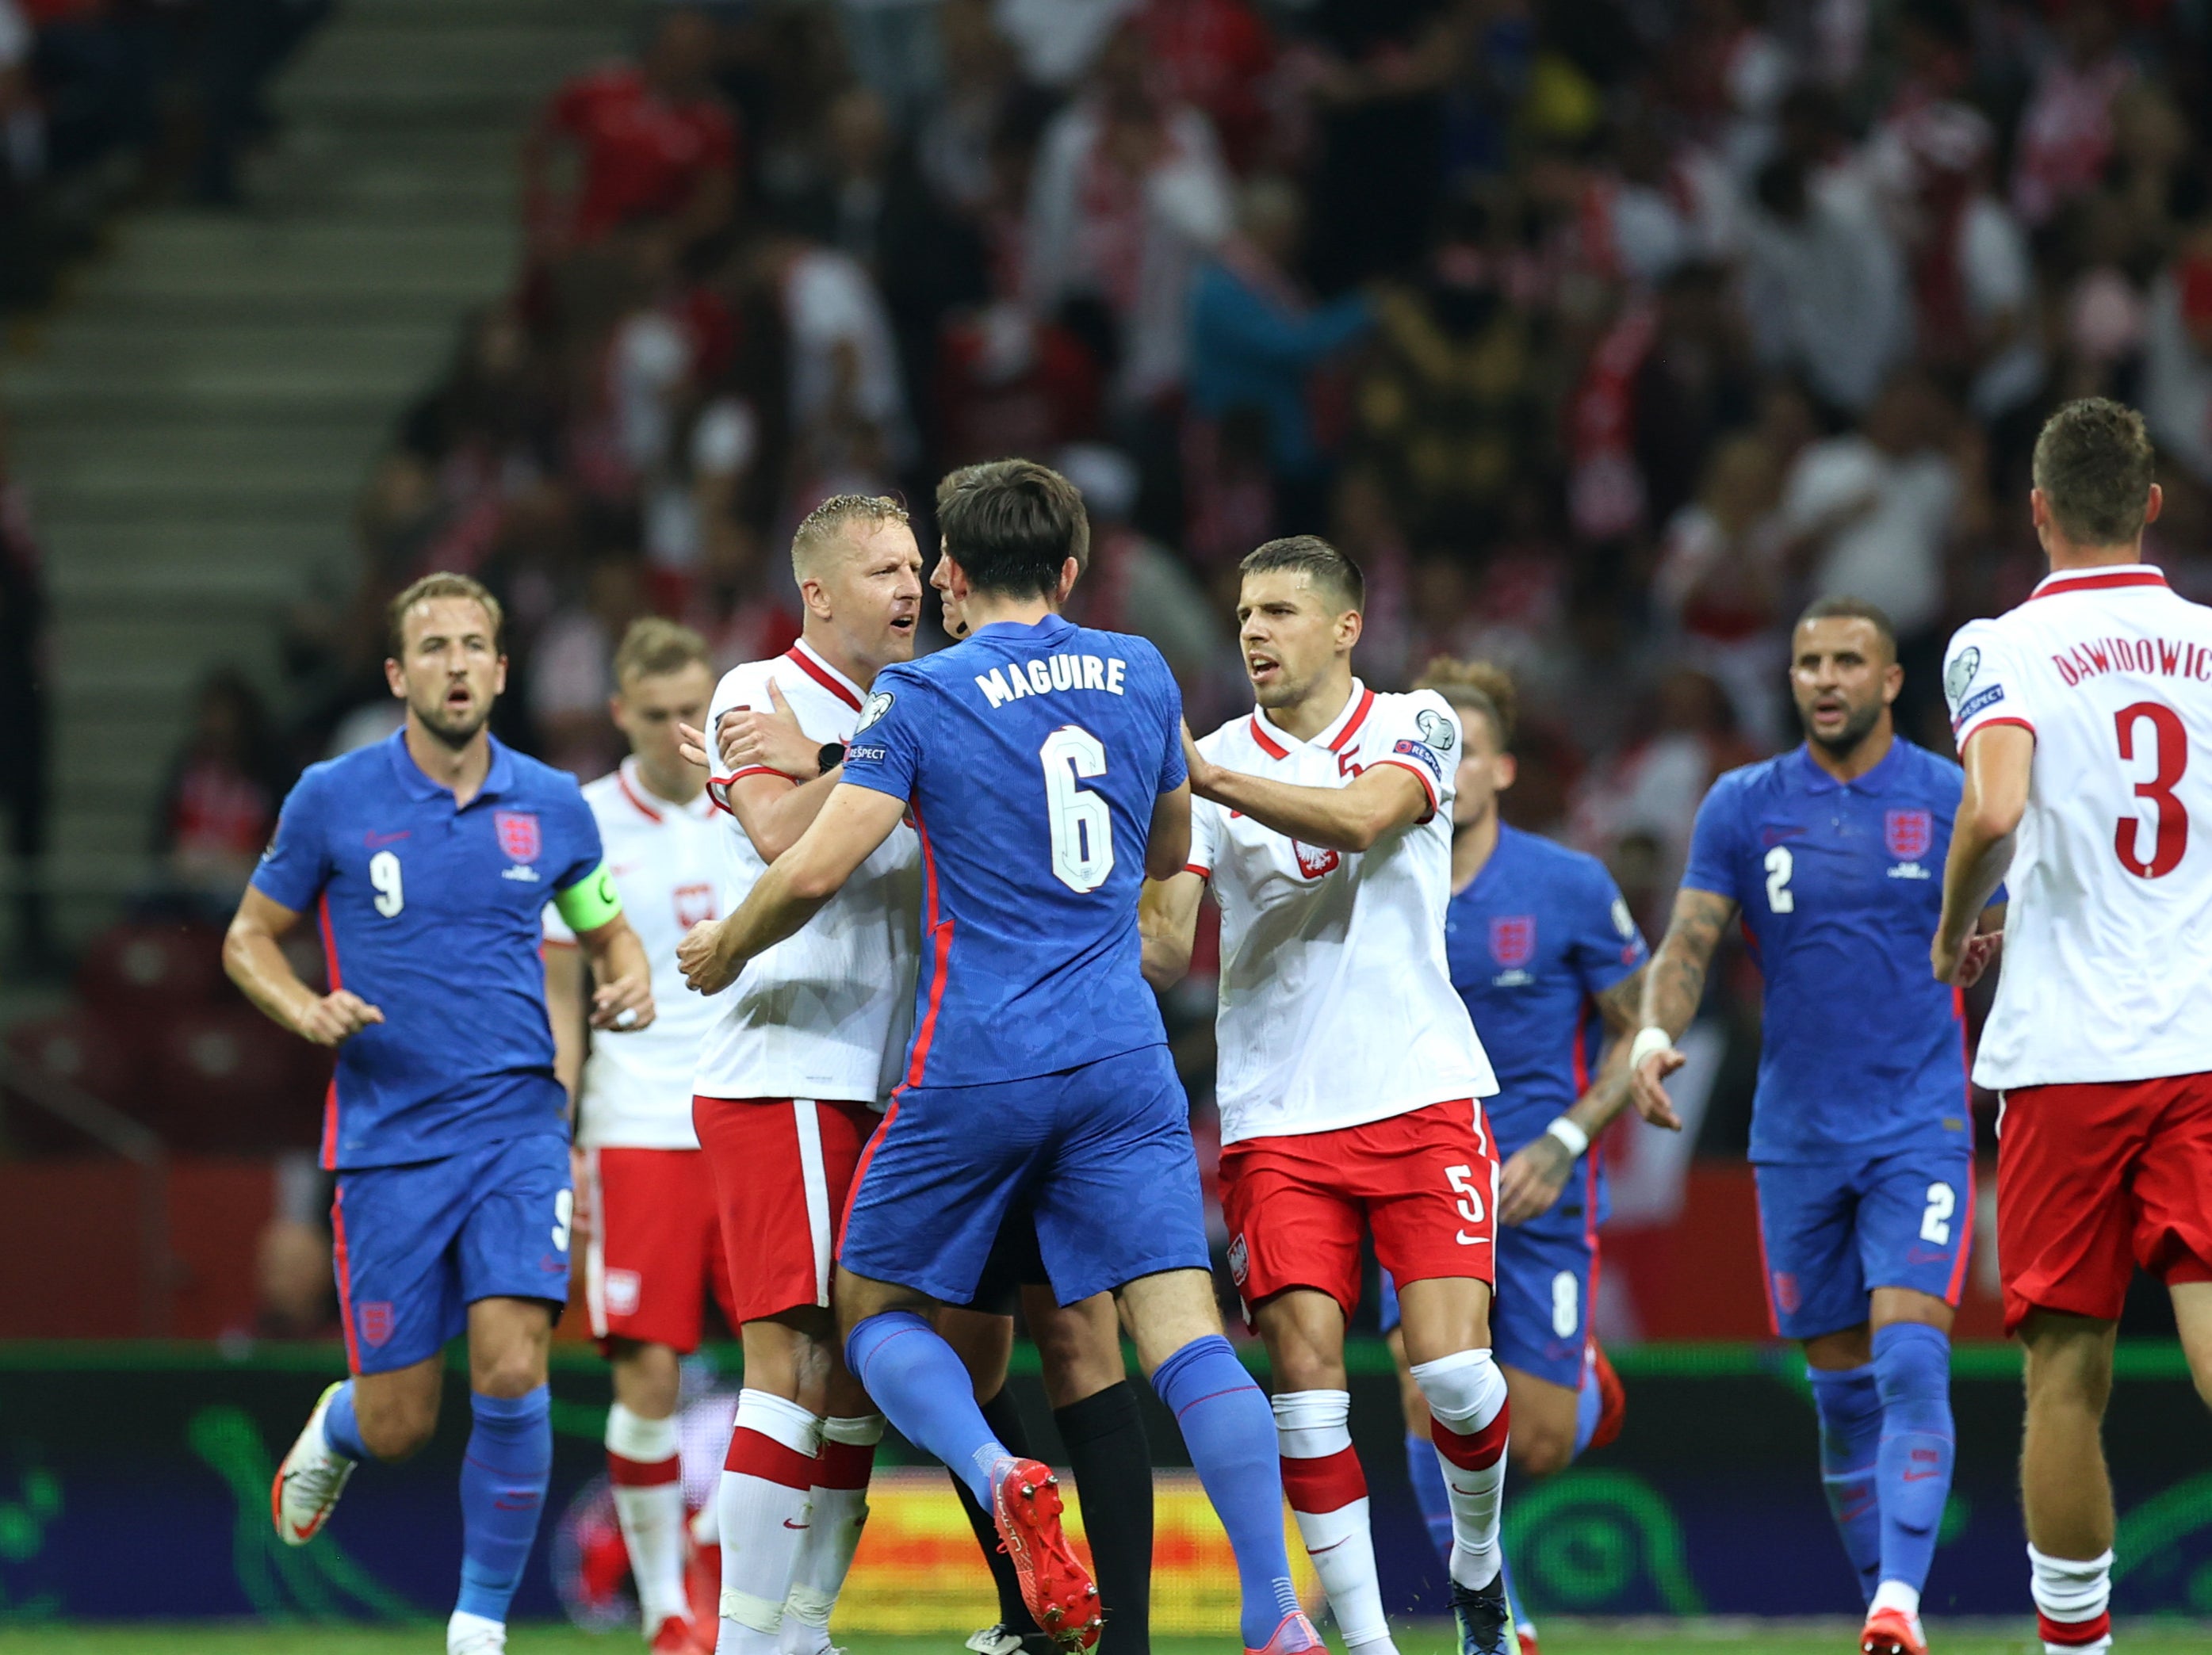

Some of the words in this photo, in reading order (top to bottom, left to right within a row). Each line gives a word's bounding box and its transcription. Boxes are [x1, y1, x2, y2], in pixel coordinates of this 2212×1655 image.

[974, 654, 1126, 709] MAGUIRE
[2052, 637, 2212, 687] DAWIDOWIC
[1039, 724, 1115, 894] 6
[2114, 701, 2188, 880] 3
[369, 850, 404, 919] 9
[1764, 845, 1794, 913] 2
[552, 1188, 573, 1252] 9
[1445, 1164, 1486, 1223] 5
[1919, 1182, 1955, 1246] 2
[1552, 1270, 1579, 1340] 8
